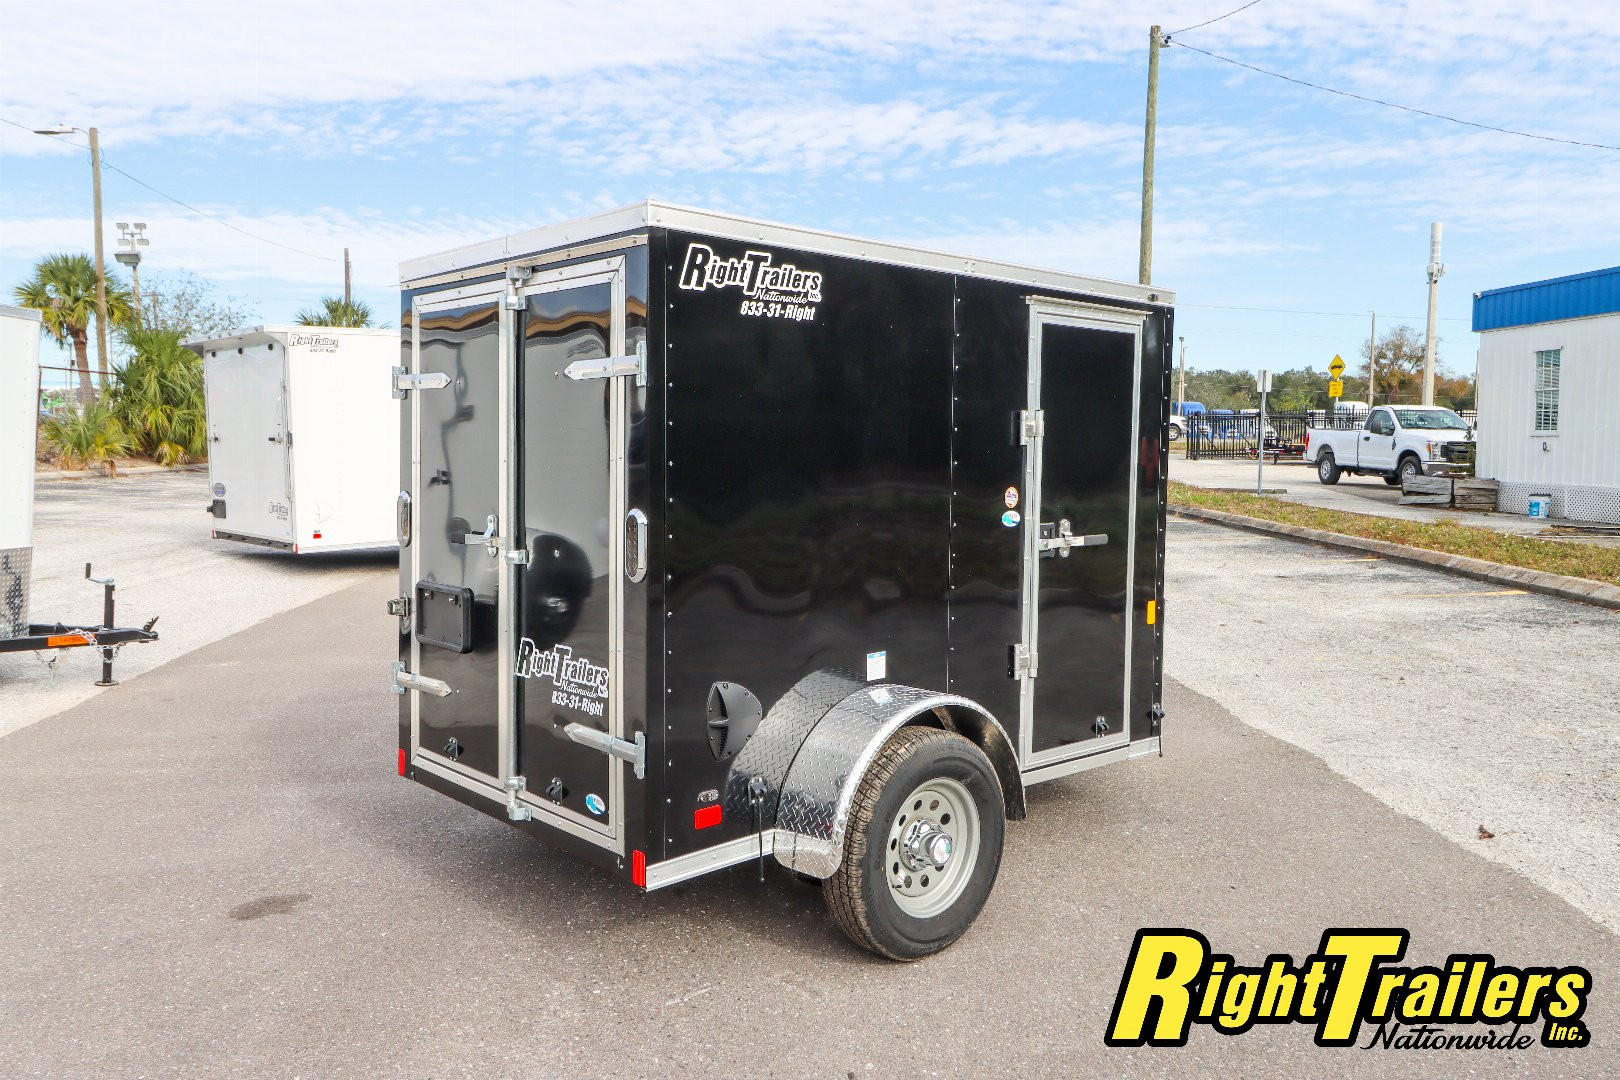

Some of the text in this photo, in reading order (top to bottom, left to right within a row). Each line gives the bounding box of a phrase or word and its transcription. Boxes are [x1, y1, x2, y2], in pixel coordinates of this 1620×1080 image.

[753, 288, 808, 305] Nationwide
[740, 300, 816, 321] 833-31-Right
[552, 691, 603, 716] 833-31-Right
